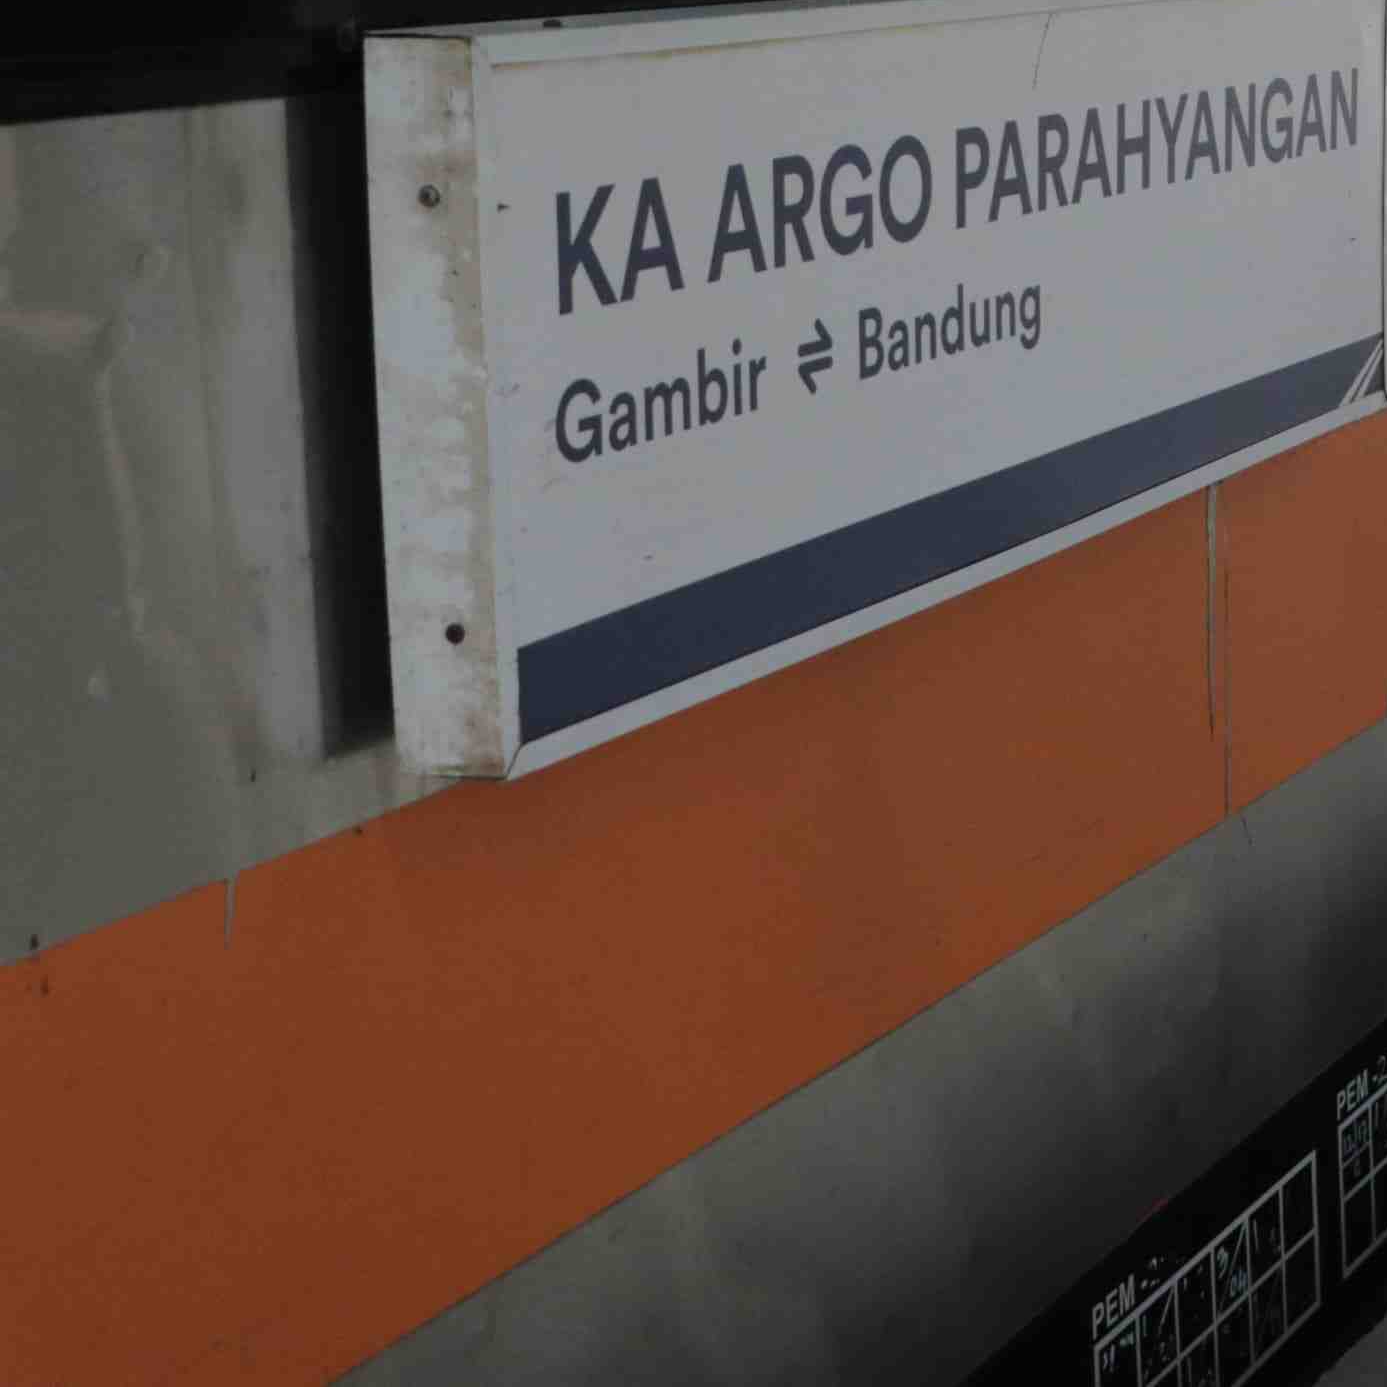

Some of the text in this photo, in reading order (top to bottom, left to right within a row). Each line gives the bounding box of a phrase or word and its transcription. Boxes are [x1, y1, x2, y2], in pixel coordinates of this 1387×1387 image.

[555, 67, 1359, 316] KA ARGO PARAHYANGAN
[555, 283, 1042, 464] Gambir Bandung
[1336, 1068, 1369, 1121] PEM
[1092, 1272, 1136, 1341] PEM
